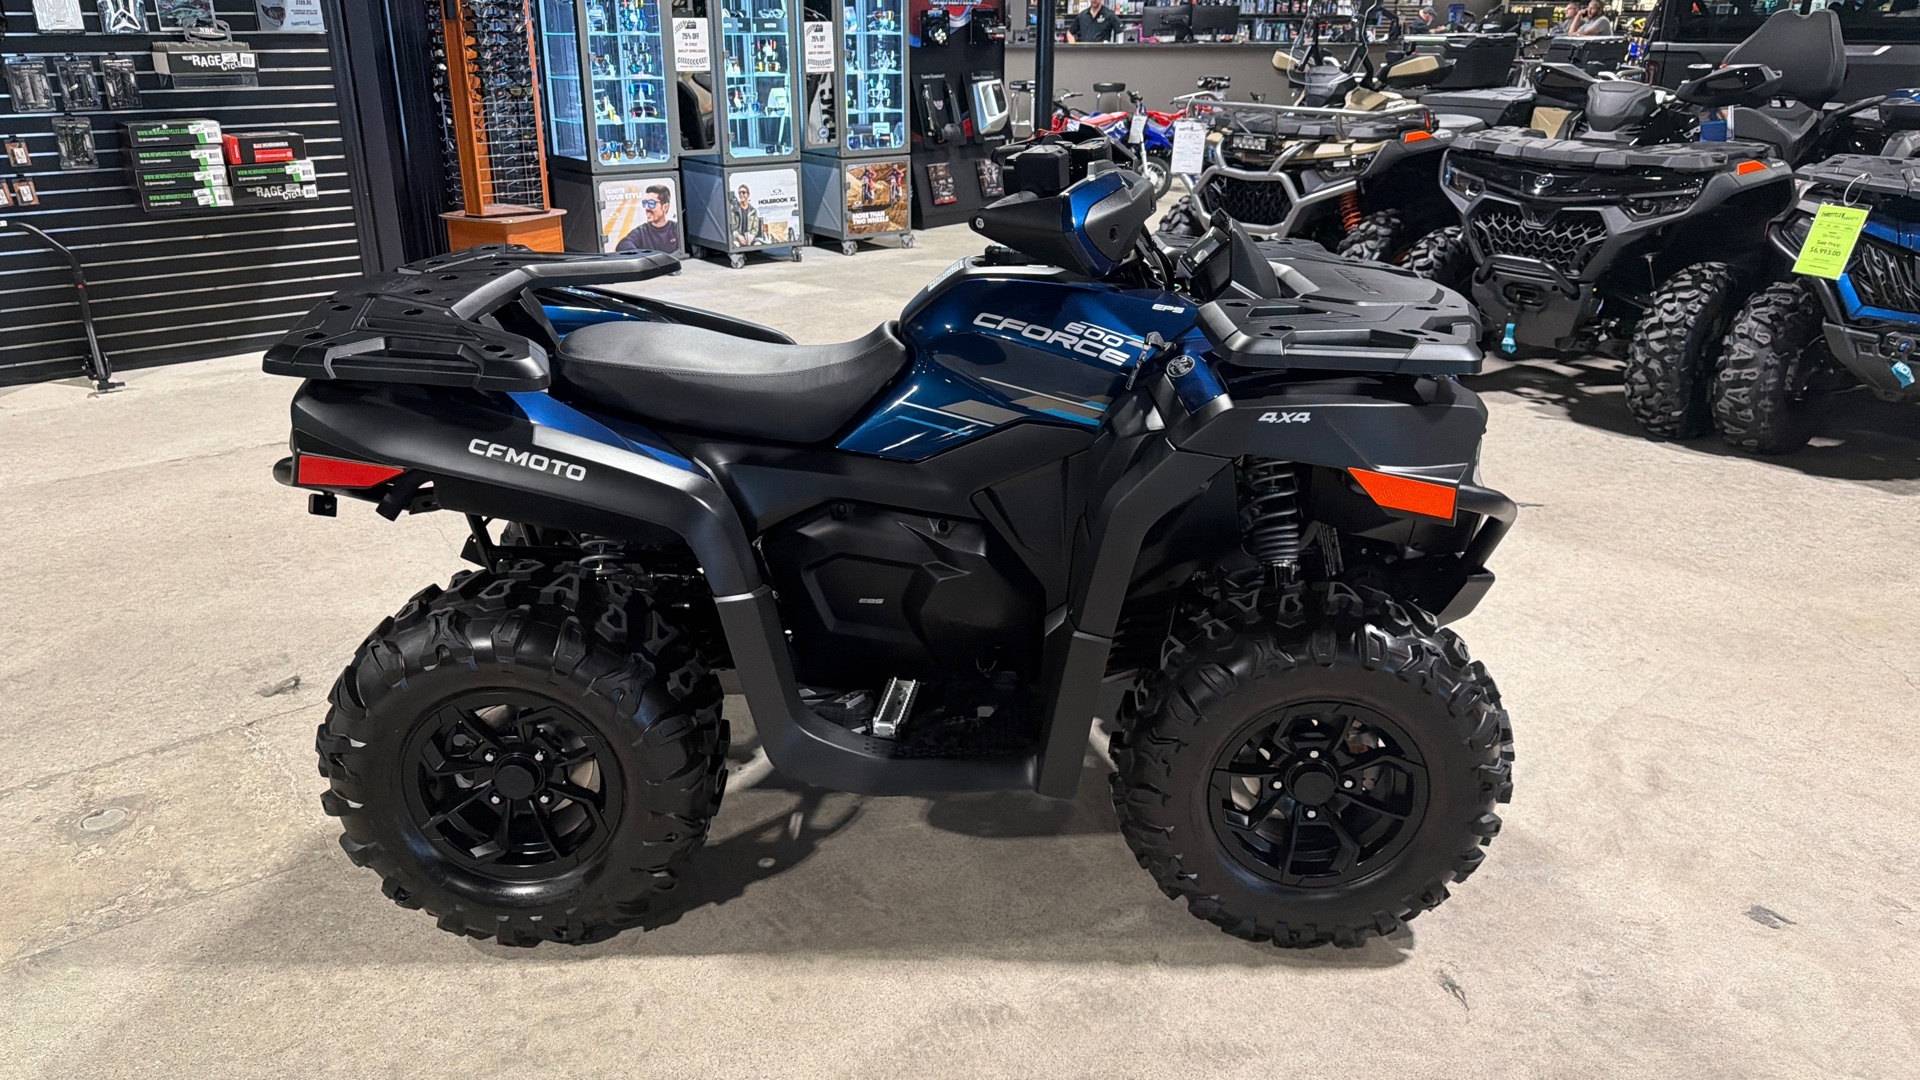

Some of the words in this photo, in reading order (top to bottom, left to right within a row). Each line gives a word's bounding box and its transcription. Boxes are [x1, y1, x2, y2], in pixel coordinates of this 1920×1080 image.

[192, 55, 221, 67] RAGE
[221, 60, 242, 71] CYCLE
[256, 186, 283, 198] RAGE
[867, 216, 890, 224] WHEELS
[868, 211, 886, 219] THAN
[1810, 246, 1842, 257] $6,993.00
[1151, 303, 1186, 314] EPS
[972, 312, 1131, 366] CFORCE
[1064, 321, 1125, 348] 600
[1258, 412, 1311, 423] 4X4
[468, 438, 587, 481] CFMOTO
